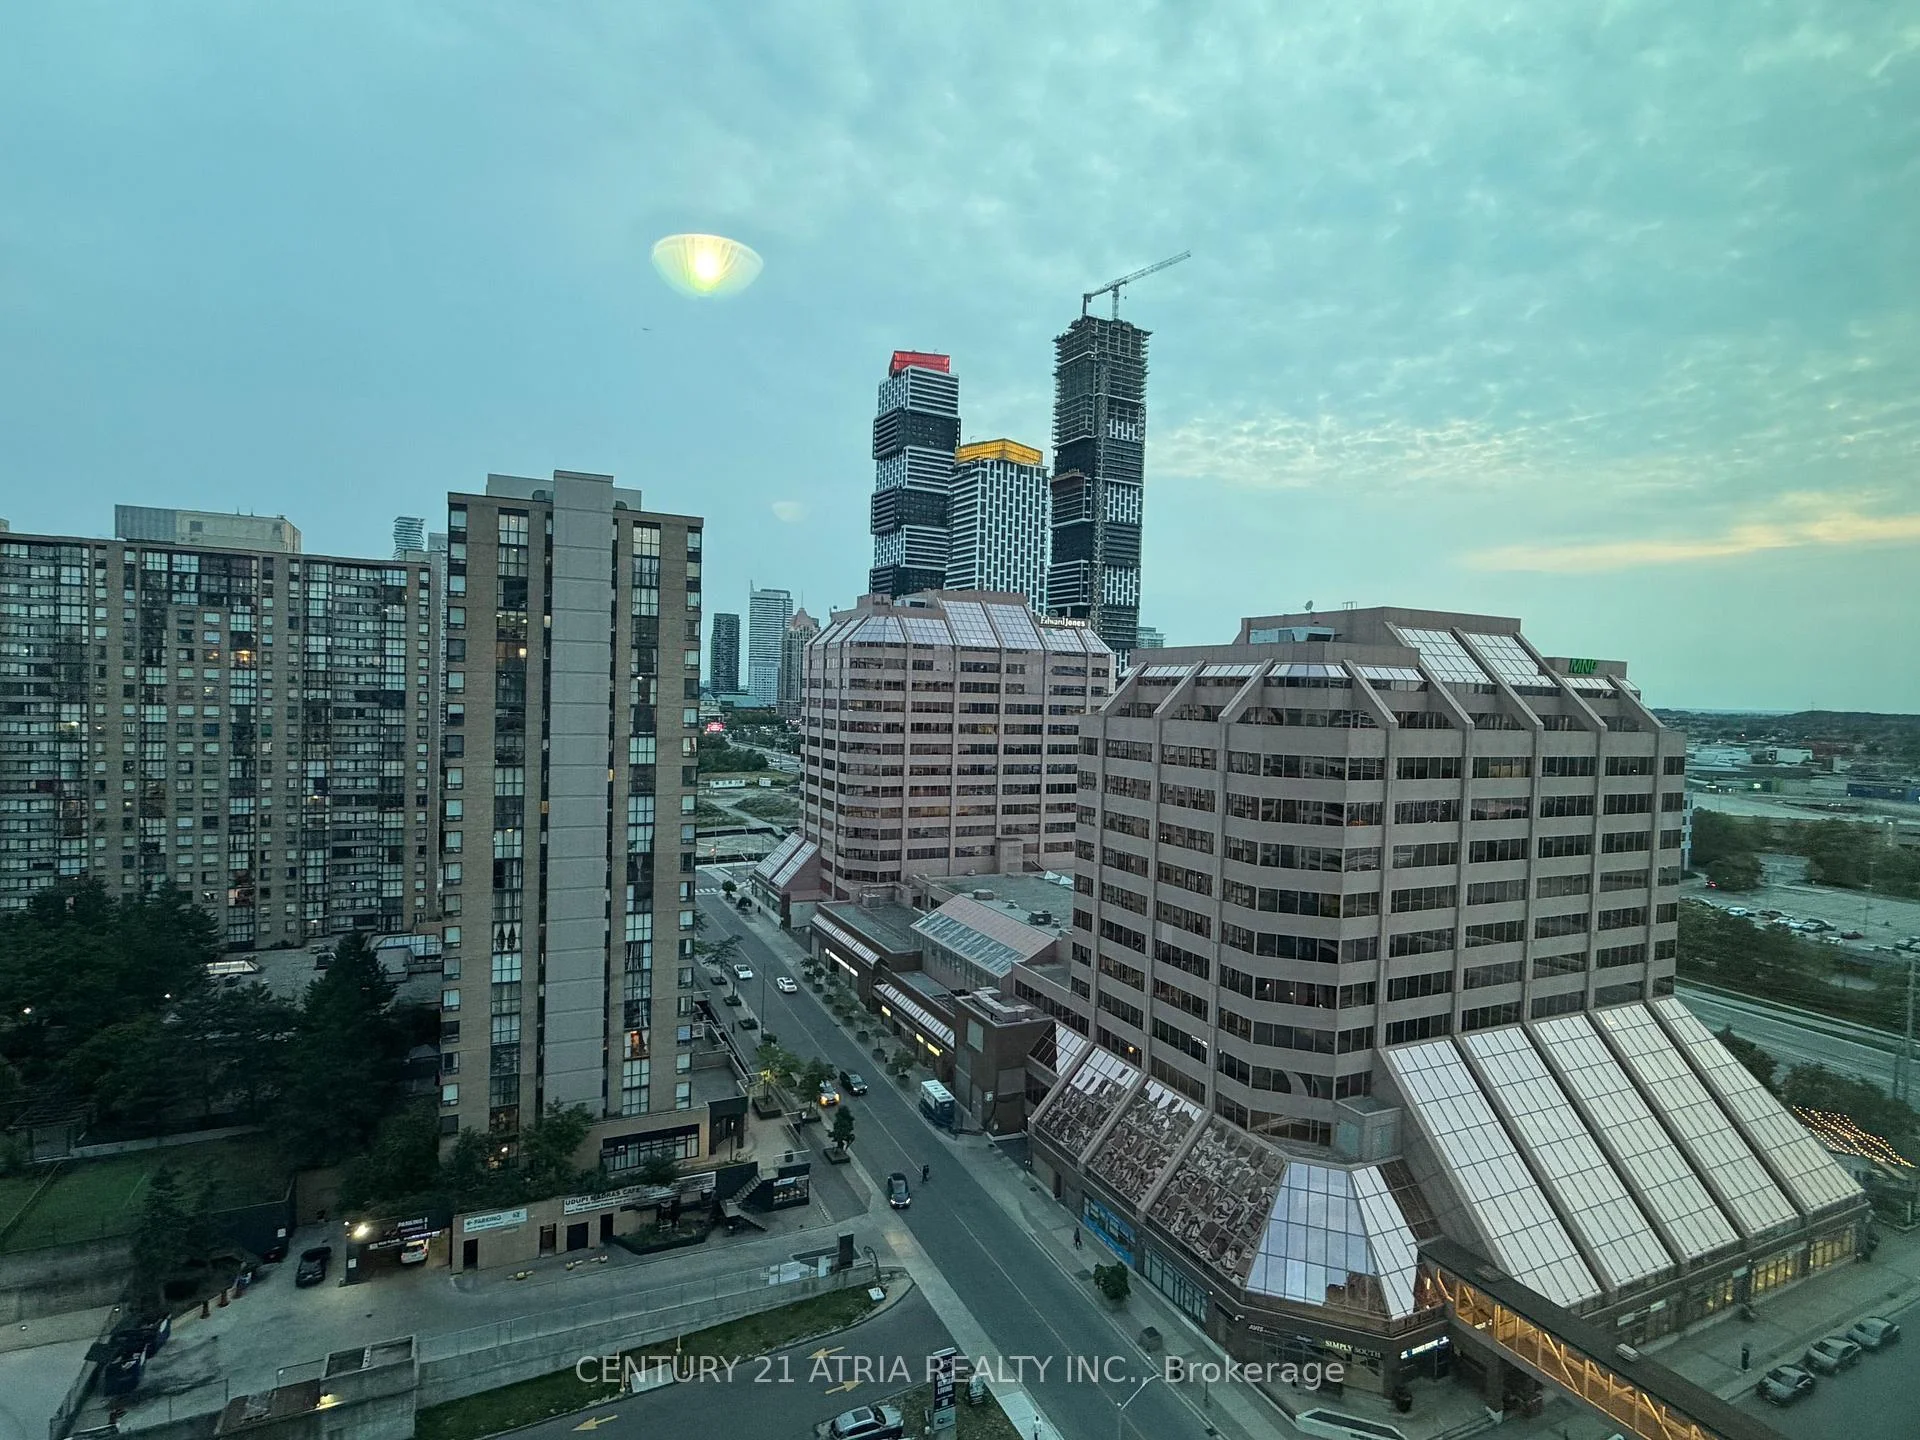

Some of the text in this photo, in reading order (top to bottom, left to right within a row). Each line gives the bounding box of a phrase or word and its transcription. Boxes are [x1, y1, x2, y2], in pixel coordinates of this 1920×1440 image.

[1065, 617, 1086, 627] Jones
[1568, 658, 1597, 674] MNP
[1325, 1340, 1353, 1352] SIMPLY
